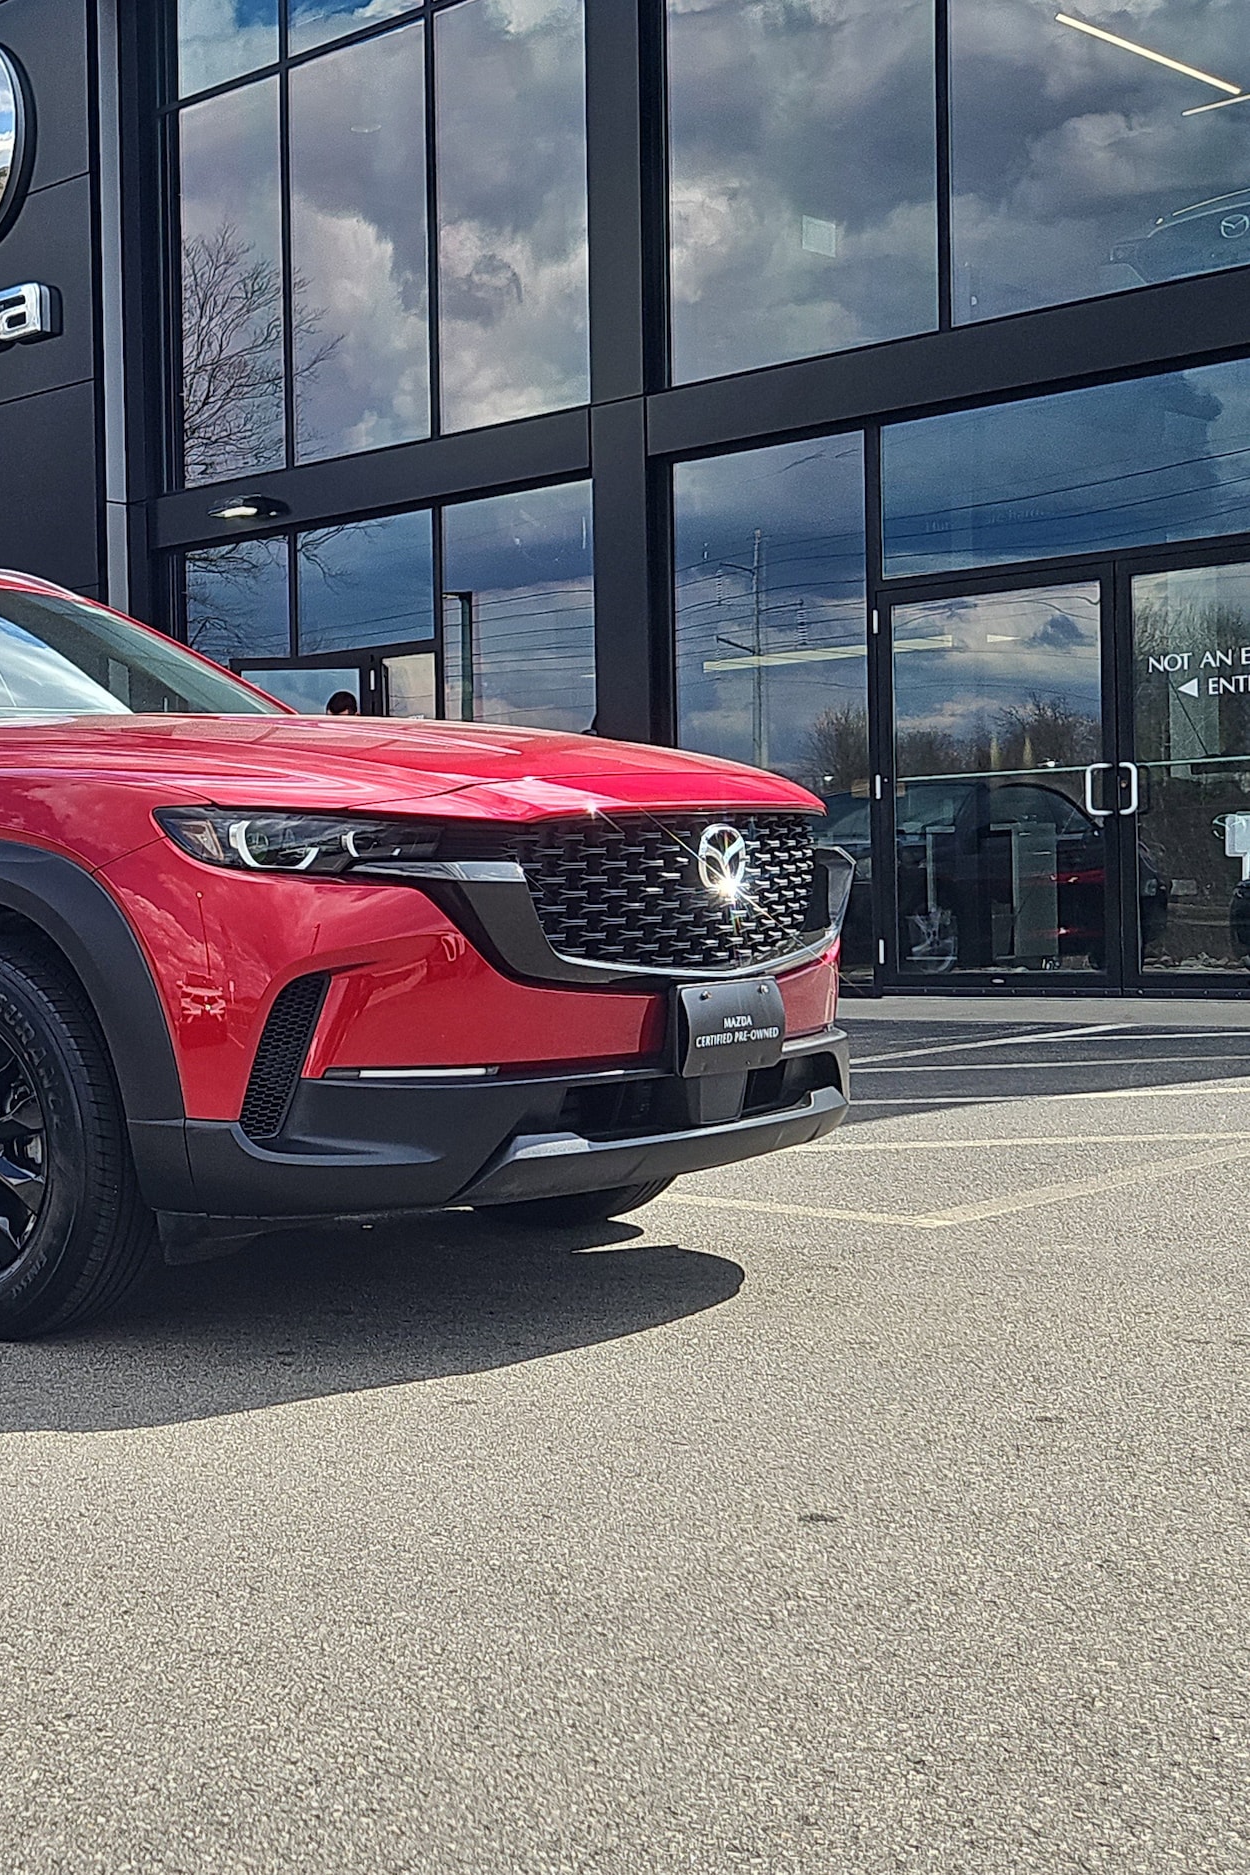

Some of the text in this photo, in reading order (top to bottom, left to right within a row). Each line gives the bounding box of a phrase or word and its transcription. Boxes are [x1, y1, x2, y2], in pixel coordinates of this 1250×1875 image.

[1148, 652, 1192, 673] NOT
[1199, 649, 1232, 668] AN
[1208, 675, 1250, 695] ENT
[723, 1015, 752, 1028] MAZDA
[695, 1027, 779, 1048] CERTIFIED PRE-OWNED
